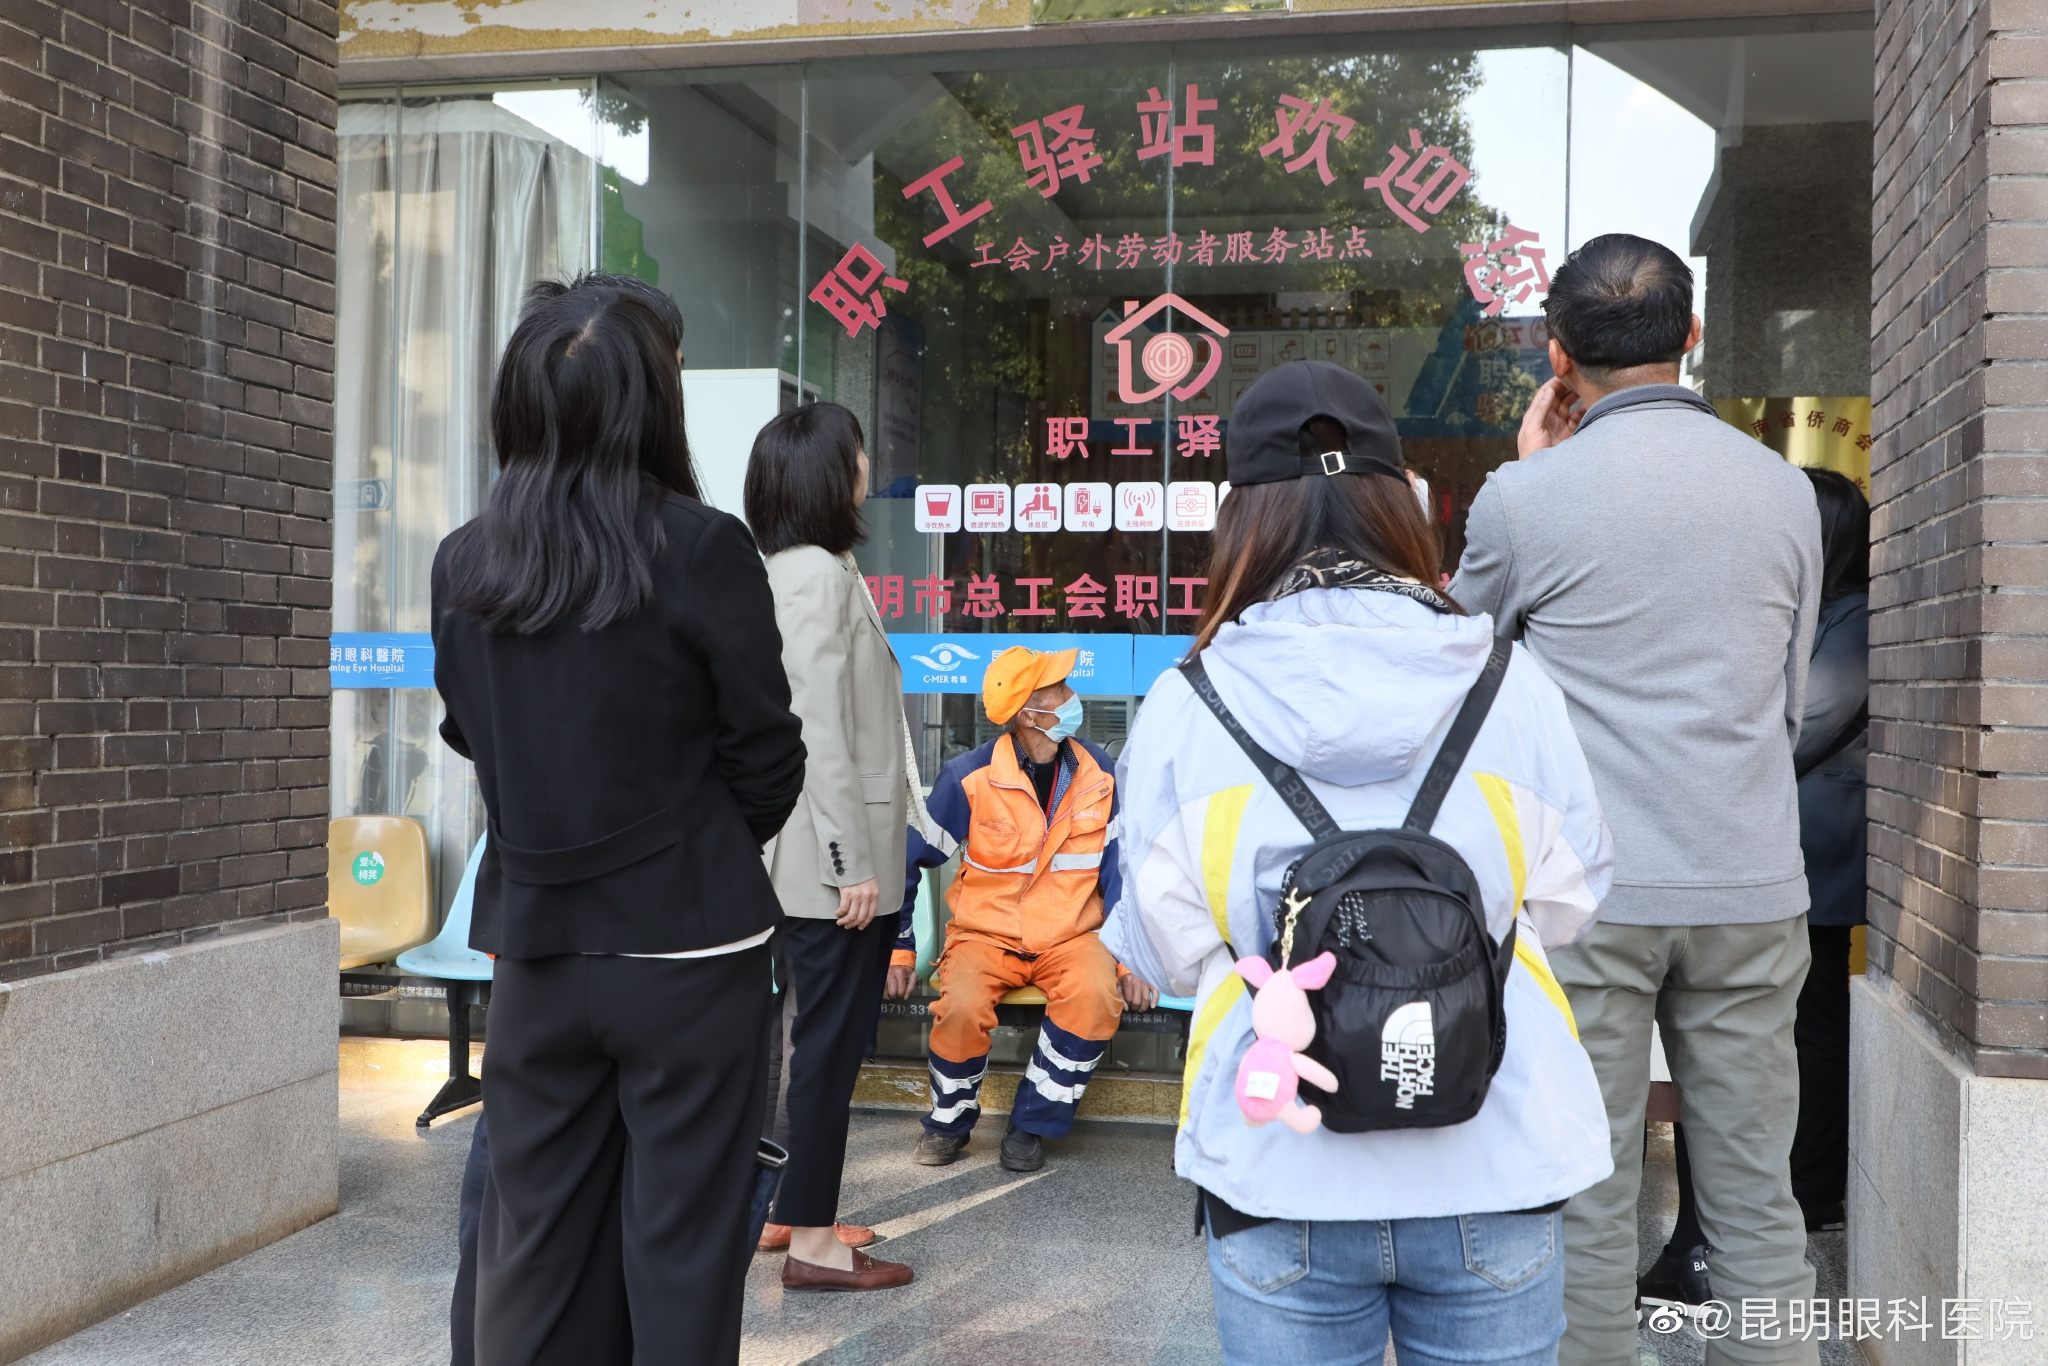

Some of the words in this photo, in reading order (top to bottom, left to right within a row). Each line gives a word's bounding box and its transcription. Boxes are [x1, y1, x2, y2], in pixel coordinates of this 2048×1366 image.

[808, 84, 1550, 338] 职工驿站欢迎您
[970, 225, 1372, 271] 工会户外劳动者服务站点
[1046, 415, 1221, 459] 职工驿
[1751, 410, 1873, 451] 南省侨商会
[970, 521, 1005, 529] 微波炉加热
[1028, 521, 1048, 529] 休息区
[1081, 520, 1095, 528] 充电
[1125, 520, 1153, 528] 无线网络
[1177, 520, 1205, 528] 应急药品
[864, 573, 1209, 619] 明市总工会职工
[330, 647, 405, 662] 明眼科醫院
[353, 664, 367, 673] Eye
[370, 663, 404, 673] Hospital
[923, 675, 949, 684] C-MER
[1282, 779, 1328, 830] FACE
[1380, 1043, 1399, 1081] THE
[1395, 1043, 1417, 1109] NORTH
[1416, 1045, 1435, 1095] FACE
